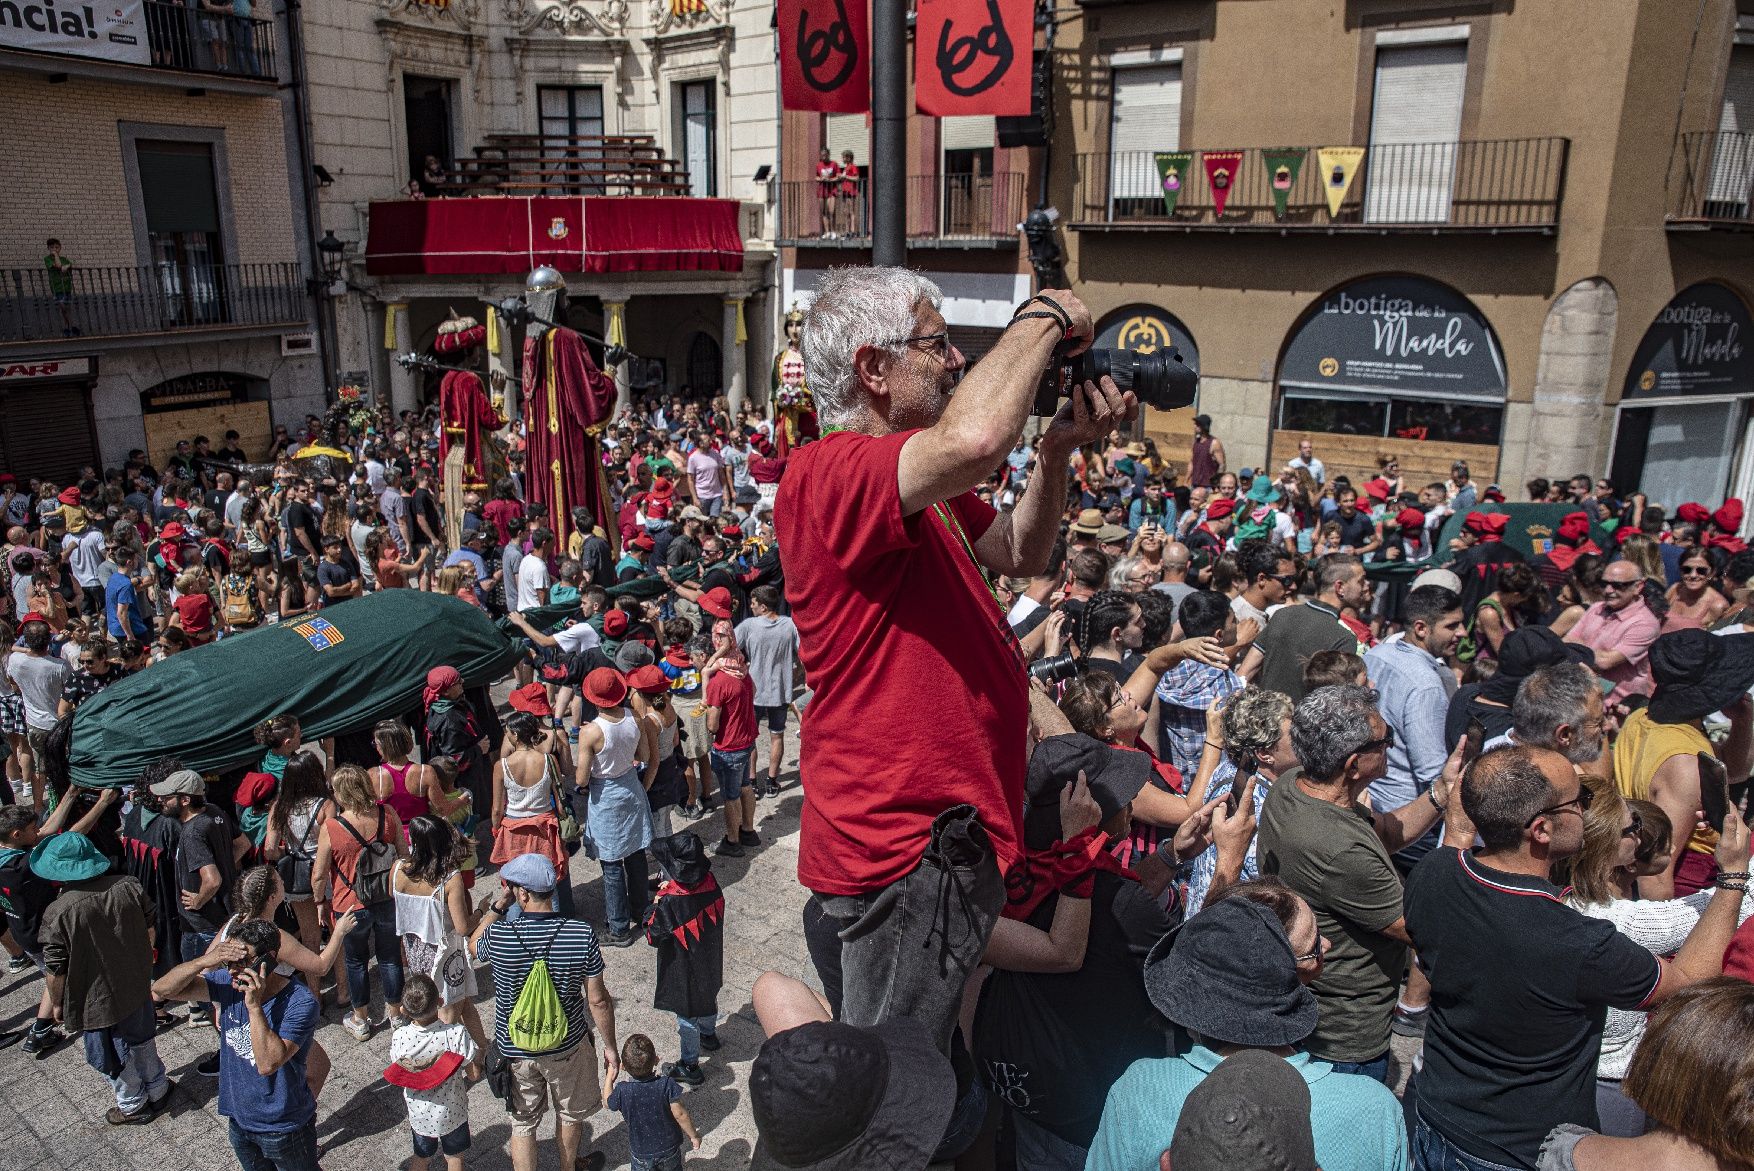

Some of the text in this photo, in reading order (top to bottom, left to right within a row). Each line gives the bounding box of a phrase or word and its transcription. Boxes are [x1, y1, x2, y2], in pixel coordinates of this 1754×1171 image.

[1340, 292, 1413, 322] botiga
[1415, 304, 1431, 317] de
[1433, 304, 1446, 318] la
